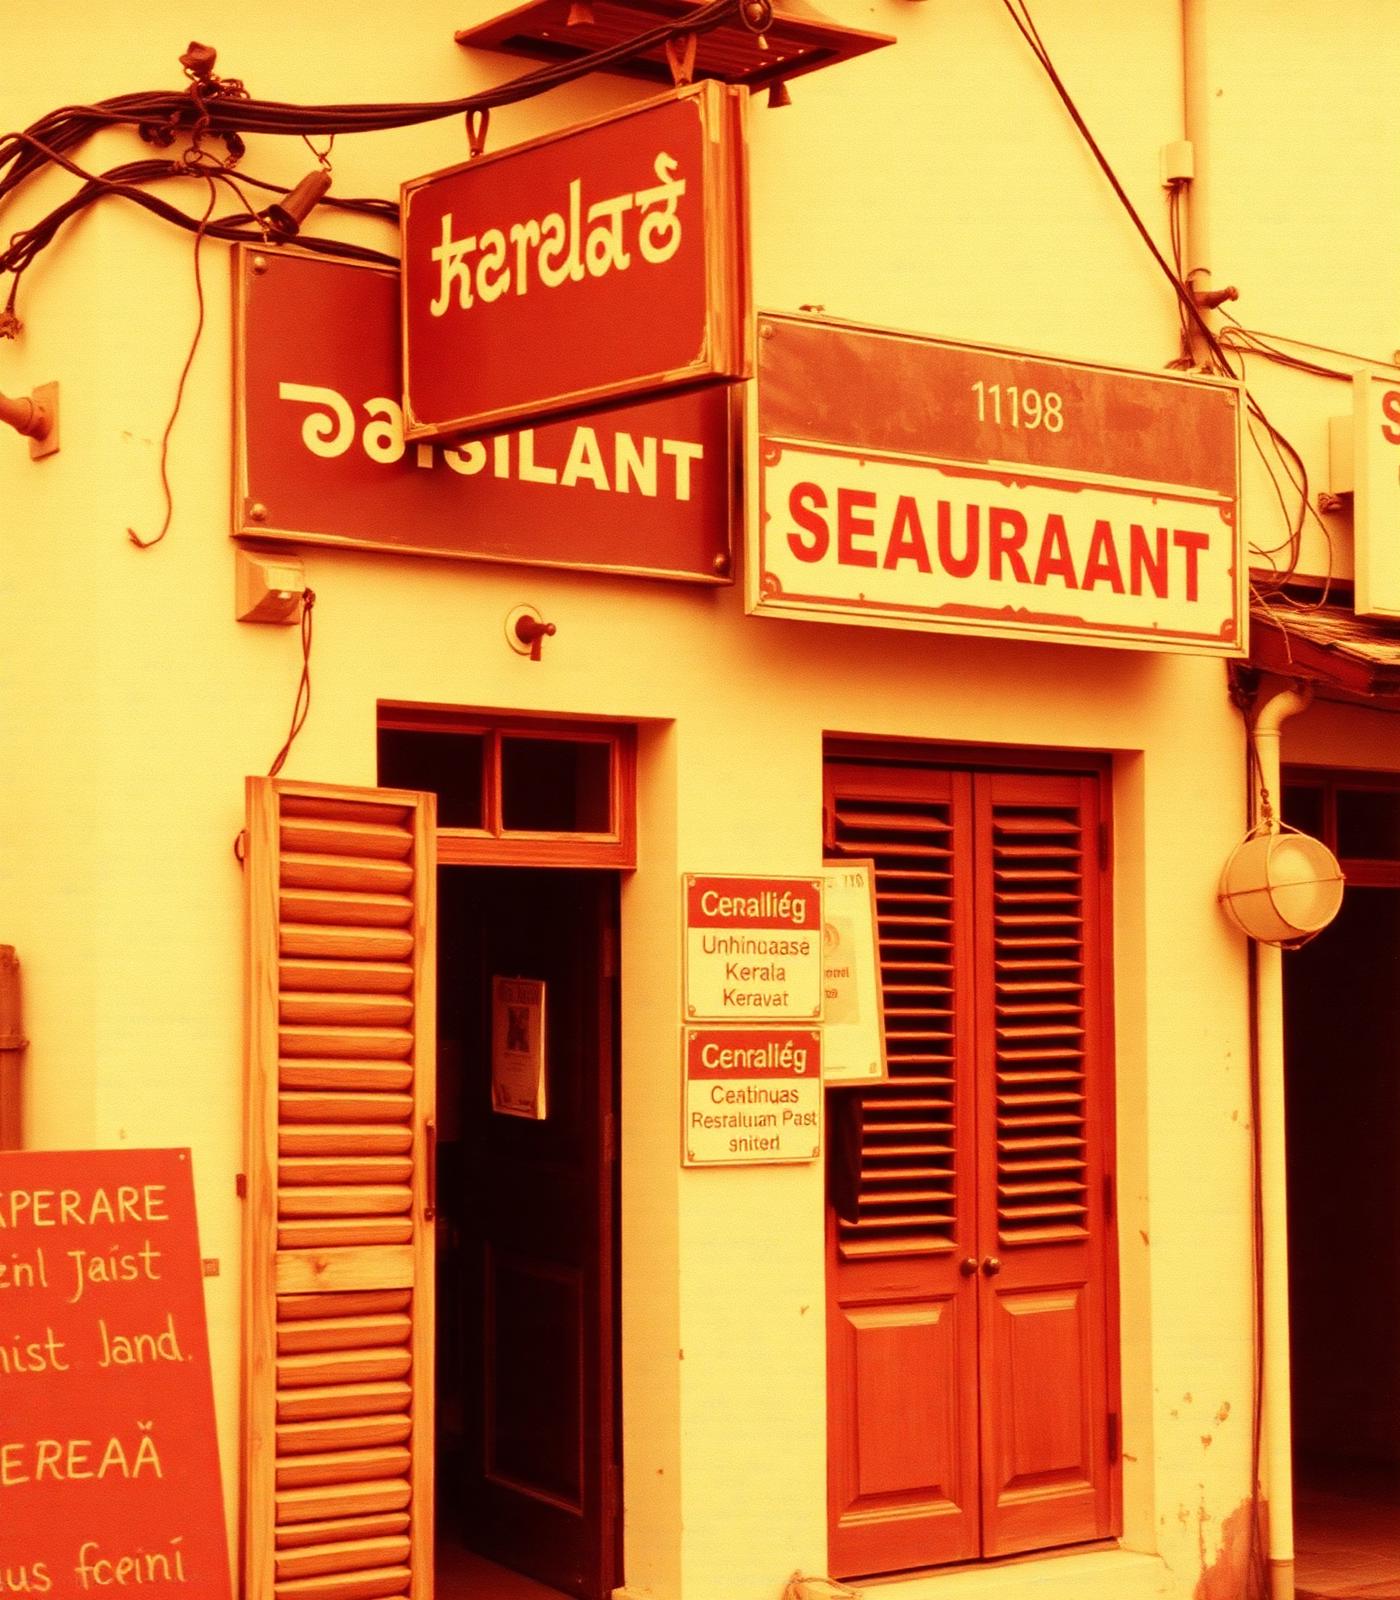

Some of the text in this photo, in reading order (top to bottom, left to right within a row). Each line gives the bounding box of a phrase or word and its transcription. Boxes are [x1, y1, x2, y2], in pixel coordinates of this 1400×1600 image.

[971, 380, 1064, 433] 11198
[787, 482, 1210, 602] SEAURAANT
[726, 963, 785, 981] Kerala
[723, 988, 789, 1007] Keravat
[0, 1185, 169, 1228] PERARE
